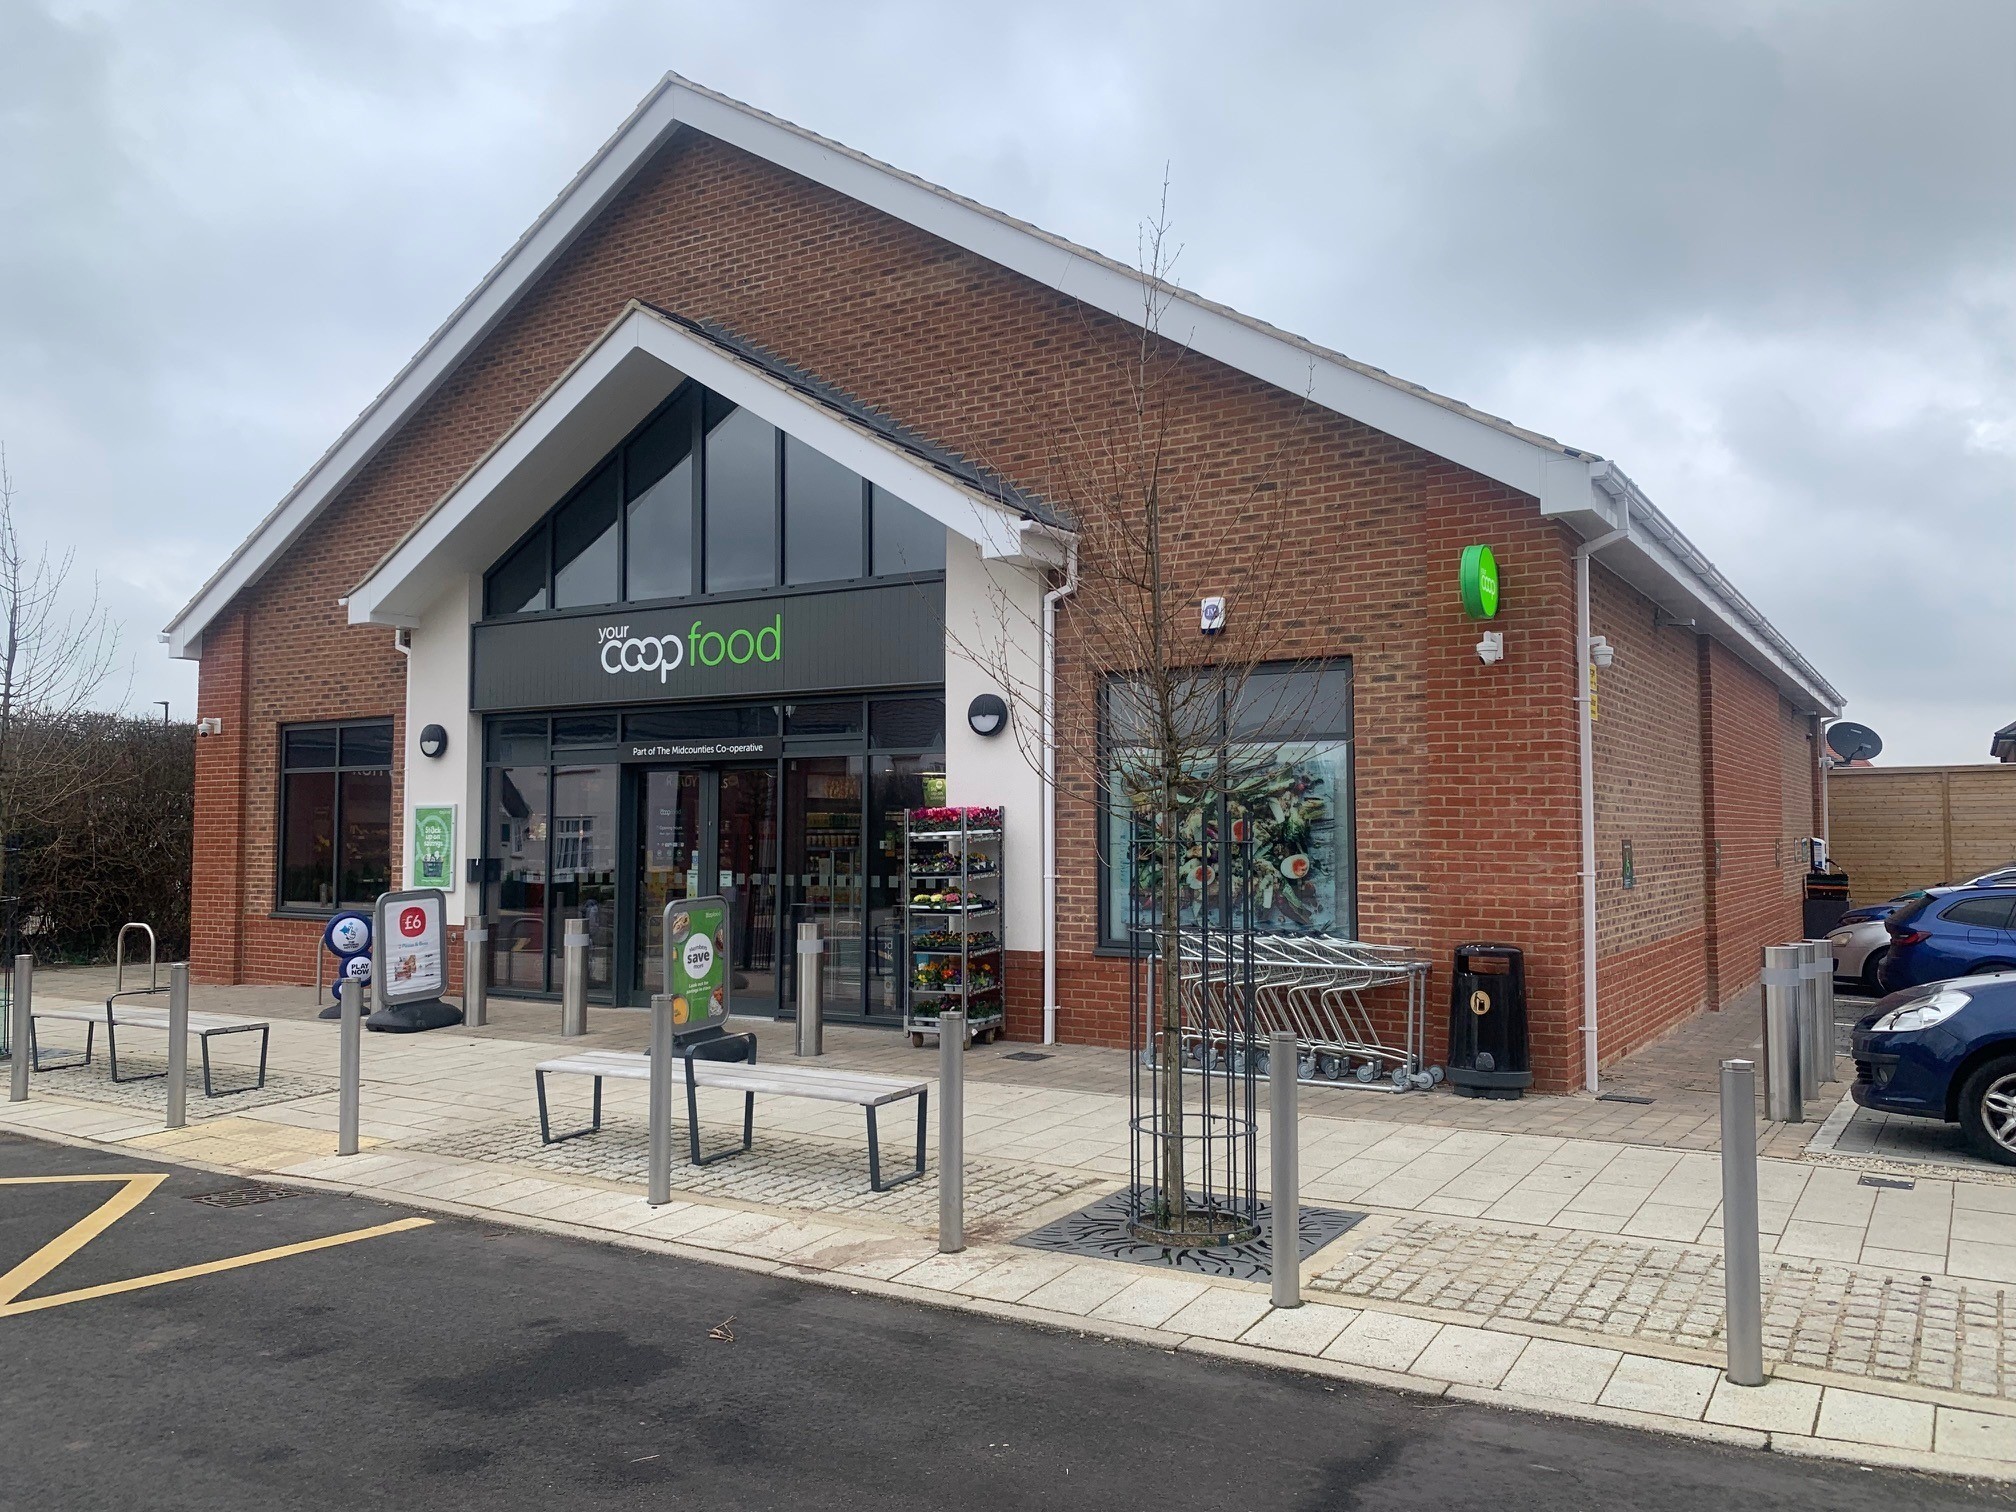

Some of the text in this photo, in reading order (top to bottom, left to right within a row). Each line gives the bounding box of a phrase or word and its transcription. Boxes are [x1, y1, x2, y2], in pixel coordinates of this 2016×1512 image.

[598, 625, 629, 644] your
[688, 613, 781, 667] food
[632, 743, 764, 756] Part of The Midcounties Co-operative
[405, 915, 422, 930] £6
[687, 951, 710, 964] save
